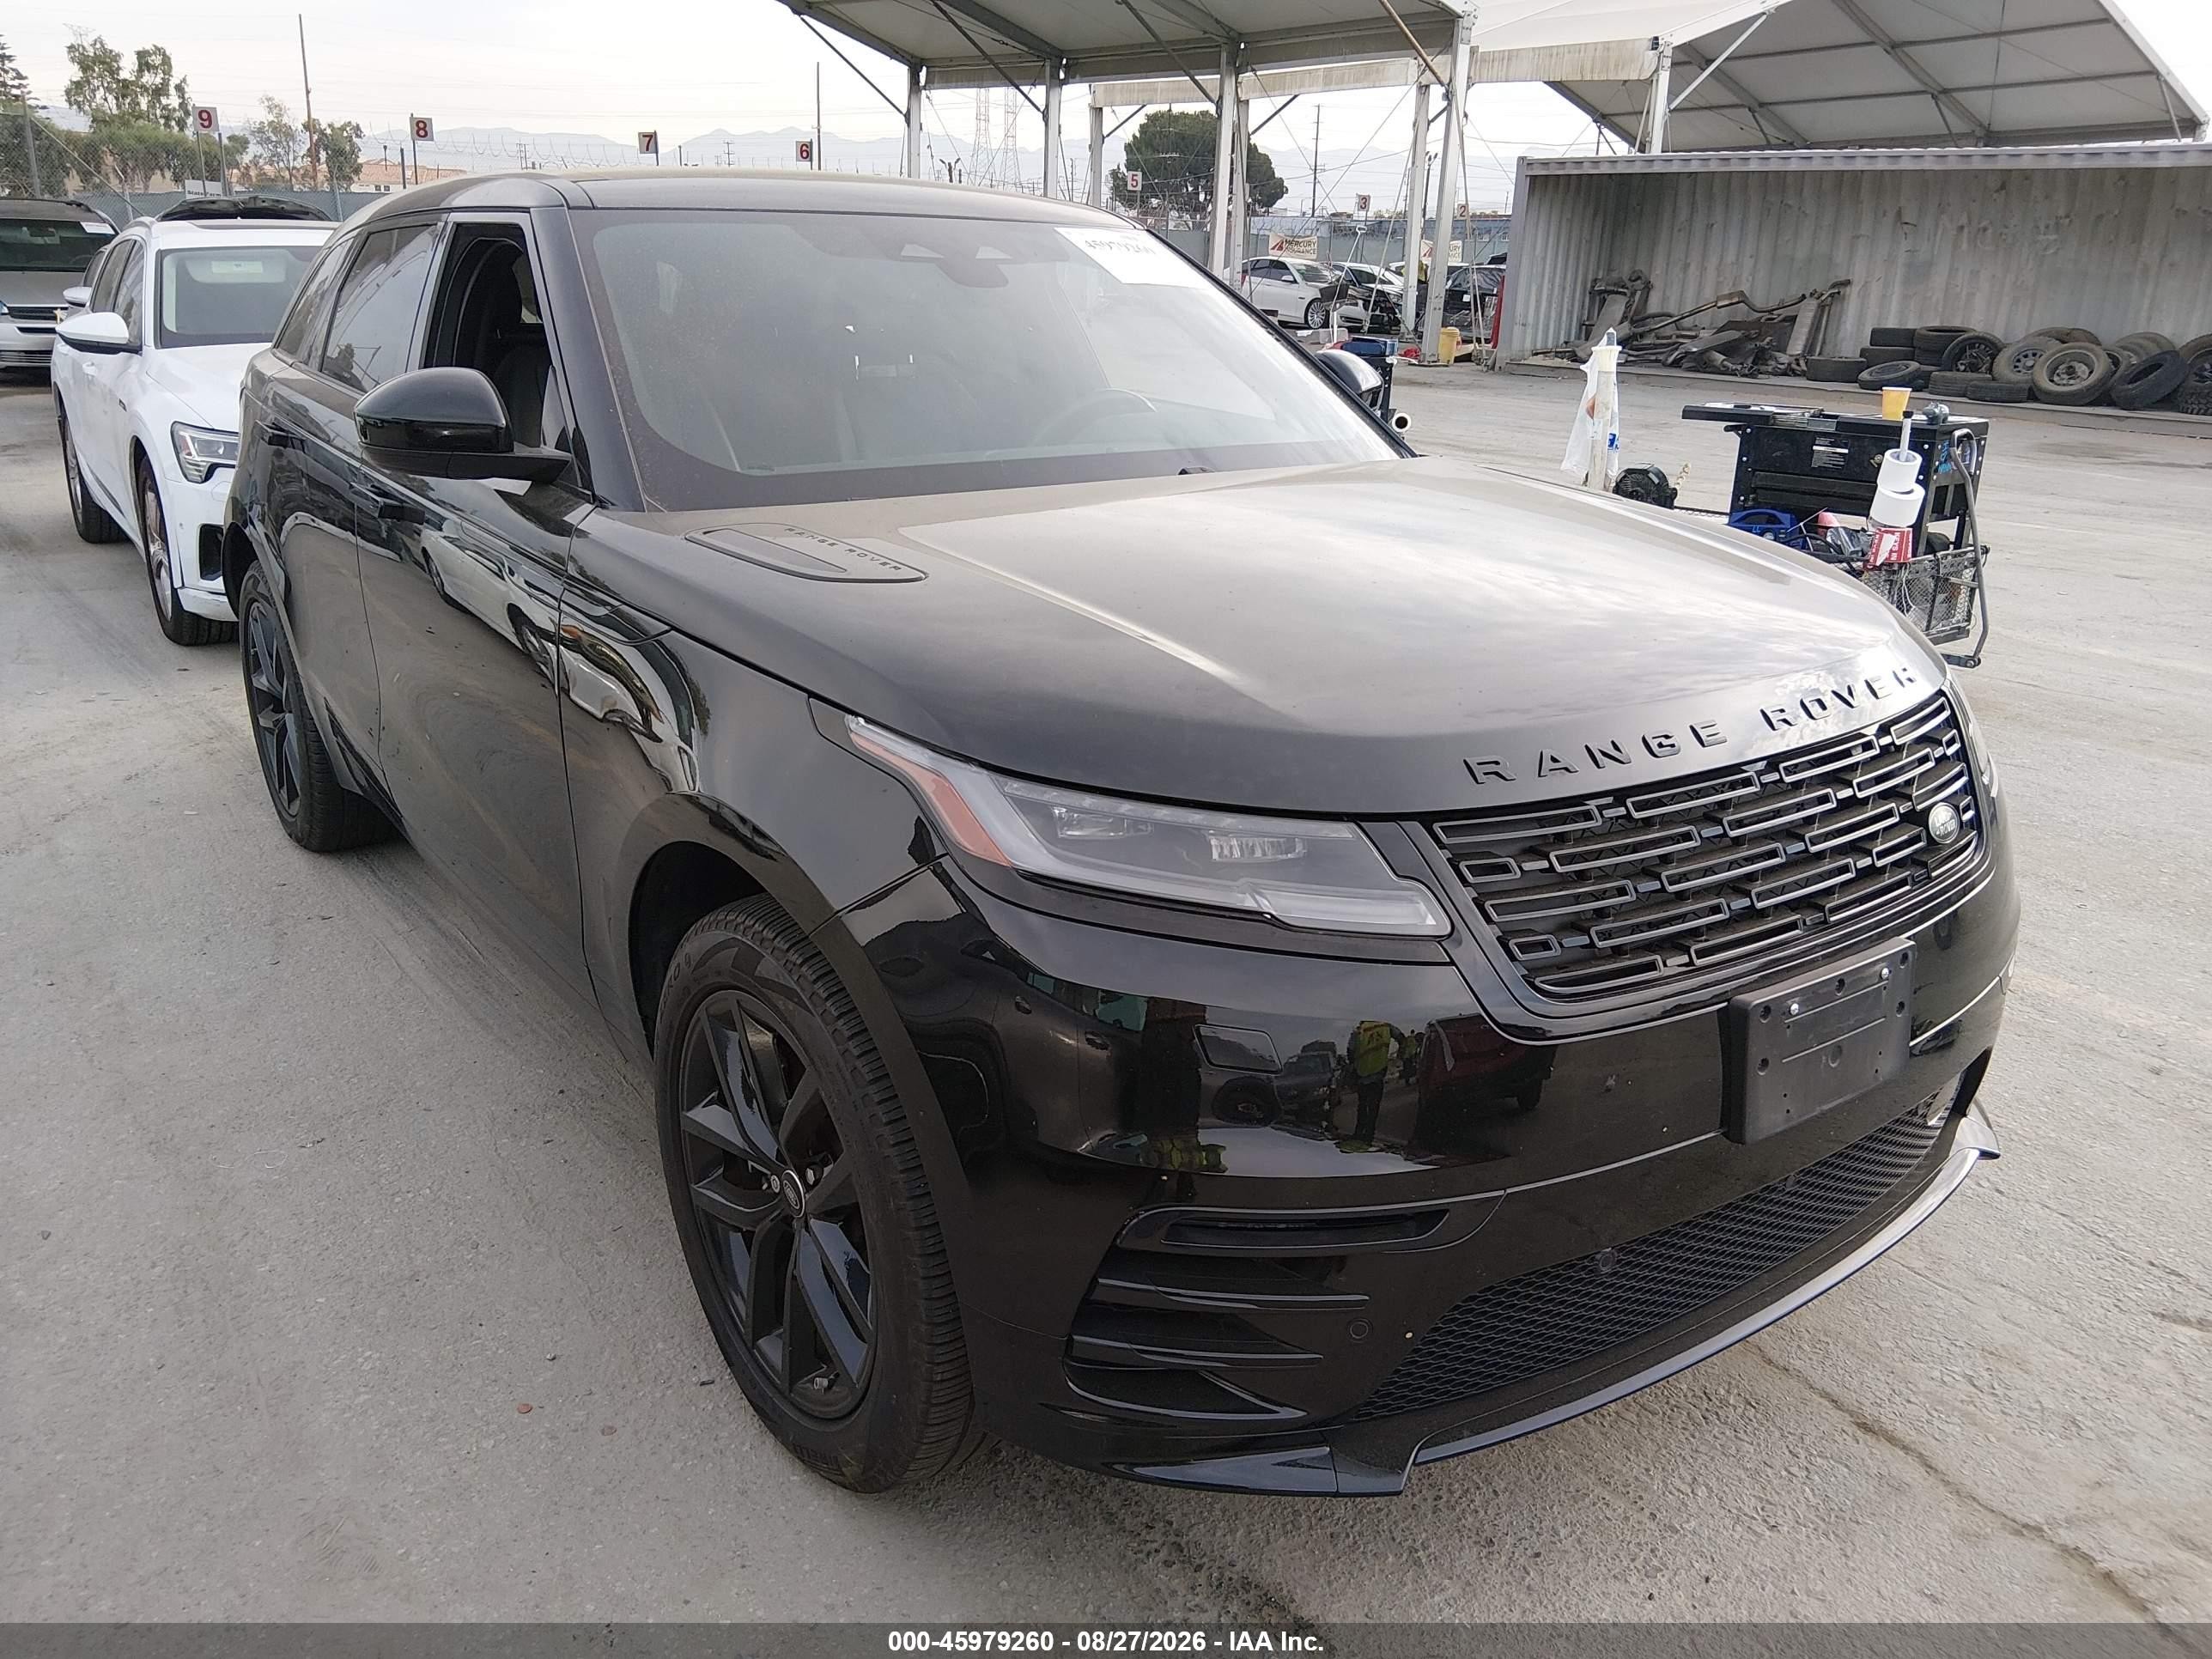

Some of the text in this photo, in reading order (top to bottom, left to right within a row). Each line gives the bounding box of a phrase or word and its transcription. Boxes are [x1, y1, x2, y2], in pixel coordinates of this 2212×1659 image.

[198, 109, 213, 129] 9
[416, 119, 428, 138] 8
[641, 134, 653, 152] 7
[799, 143, 810, 160] 6
[1130, 173, 1139, 188] 5
[1359, 197, 1368, 210] 3
[1459, 205, 1467, 217] 2
[1285, 239, 1317, 248] MERCURY
[784, 527, 902, 571] RANGE ROVER
[1462, 665, 1917, 785] RANGE ROVER
